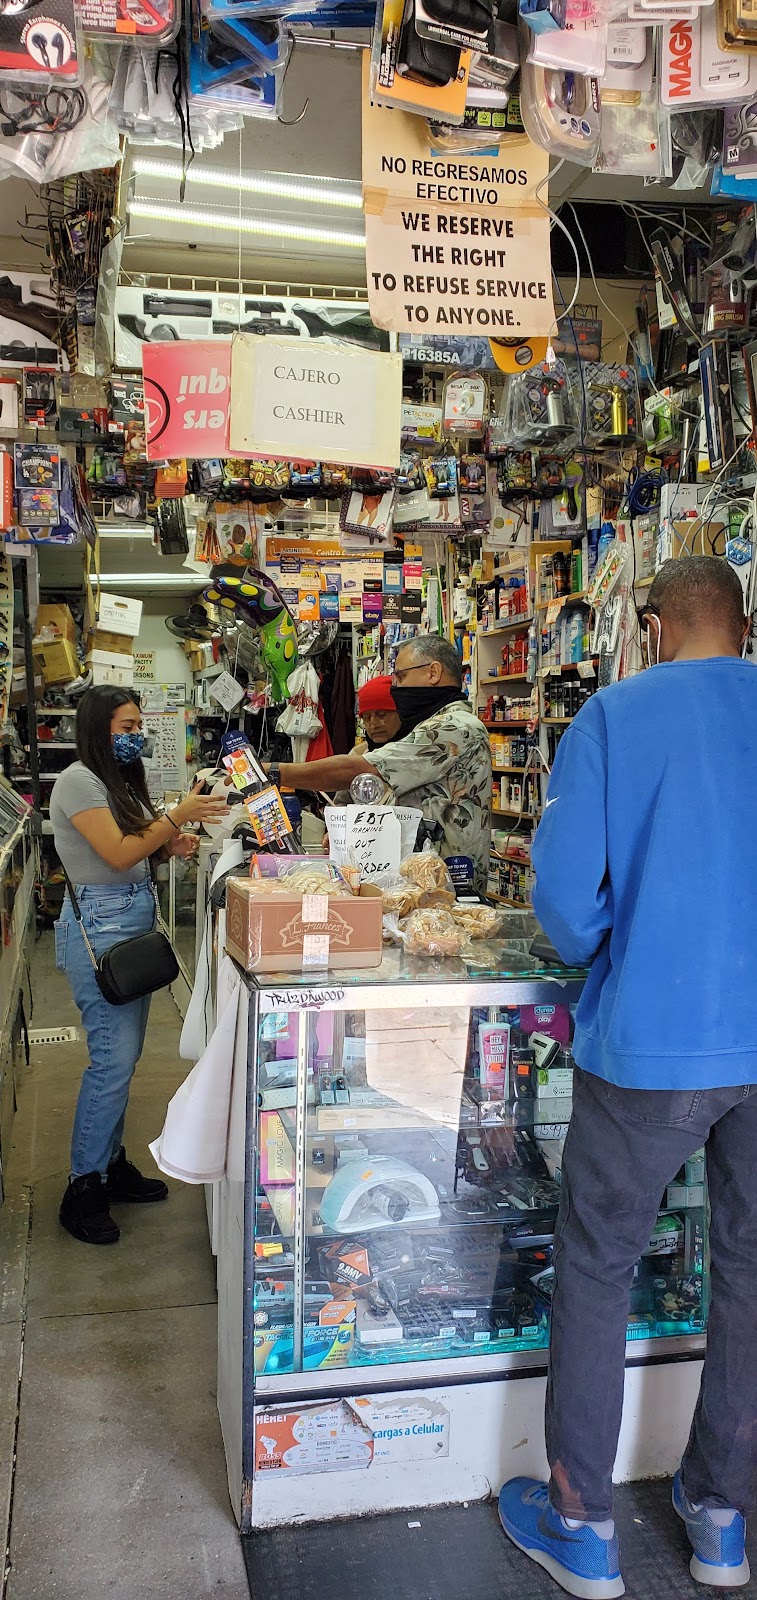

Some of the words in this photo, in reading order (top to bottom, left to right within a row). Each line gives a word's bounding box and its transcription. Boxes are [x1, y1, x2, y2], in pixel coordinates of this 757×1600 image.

[28, 15, 61, 27] Earphones
[60, 23, 77, 53] Included
[427, 25, 450, 36] UNIVERSAL
[381, 156, 407, 174] NO
[412, 160, 528, 186] REGRESAMOS
[416, 183, 498, 205] EFECTIVO
[401, 211, 430, 232] WE
[437, 214, 514, 238] RESERVE
[412, 245, 445, 264] THE
[451, 247, 506, 268] RIGHT
[372, 273, 397, 291] TO
[403, 274, 469, 296] REFUSE
[476, 279, 547, 299] SERVICE
[405, 305, 429, 323] TO
[436, 307, 521, 327] ANYONE.
[402, 347, 461, 364] P16385A
[273, 365, 341, 386] CAJERO
[272, 405, 346, 426] CASHIER
[21, 457, 53, 470] CHAMPIONS
[316, 549, 341, 557] Centro
[354, 811, 393, 826] EBT
[351, 825, 384, 834] MACHINE
[354, 838, 376, 849] OUT
[360, 850, 373, 860] OF
[358, 862, 392, 874] ORDER
[304, 921, 342, 933] Frances
[535, 1006, 554, 1014] durex
[276, 1119, 284, 1138] LOVE
[276, 1140, 284, 1168] MAGIC
[337, 1262, 363, 1279] 9.8MV
[307, 1327, 339, 1338] FORCE
[372, 1428, 403, 1440] cargas
[404, 1428, 410, 1436] a
[412, 1422, 445, 1435] Celular
[259, 1452, 282, 1460] BOSS
